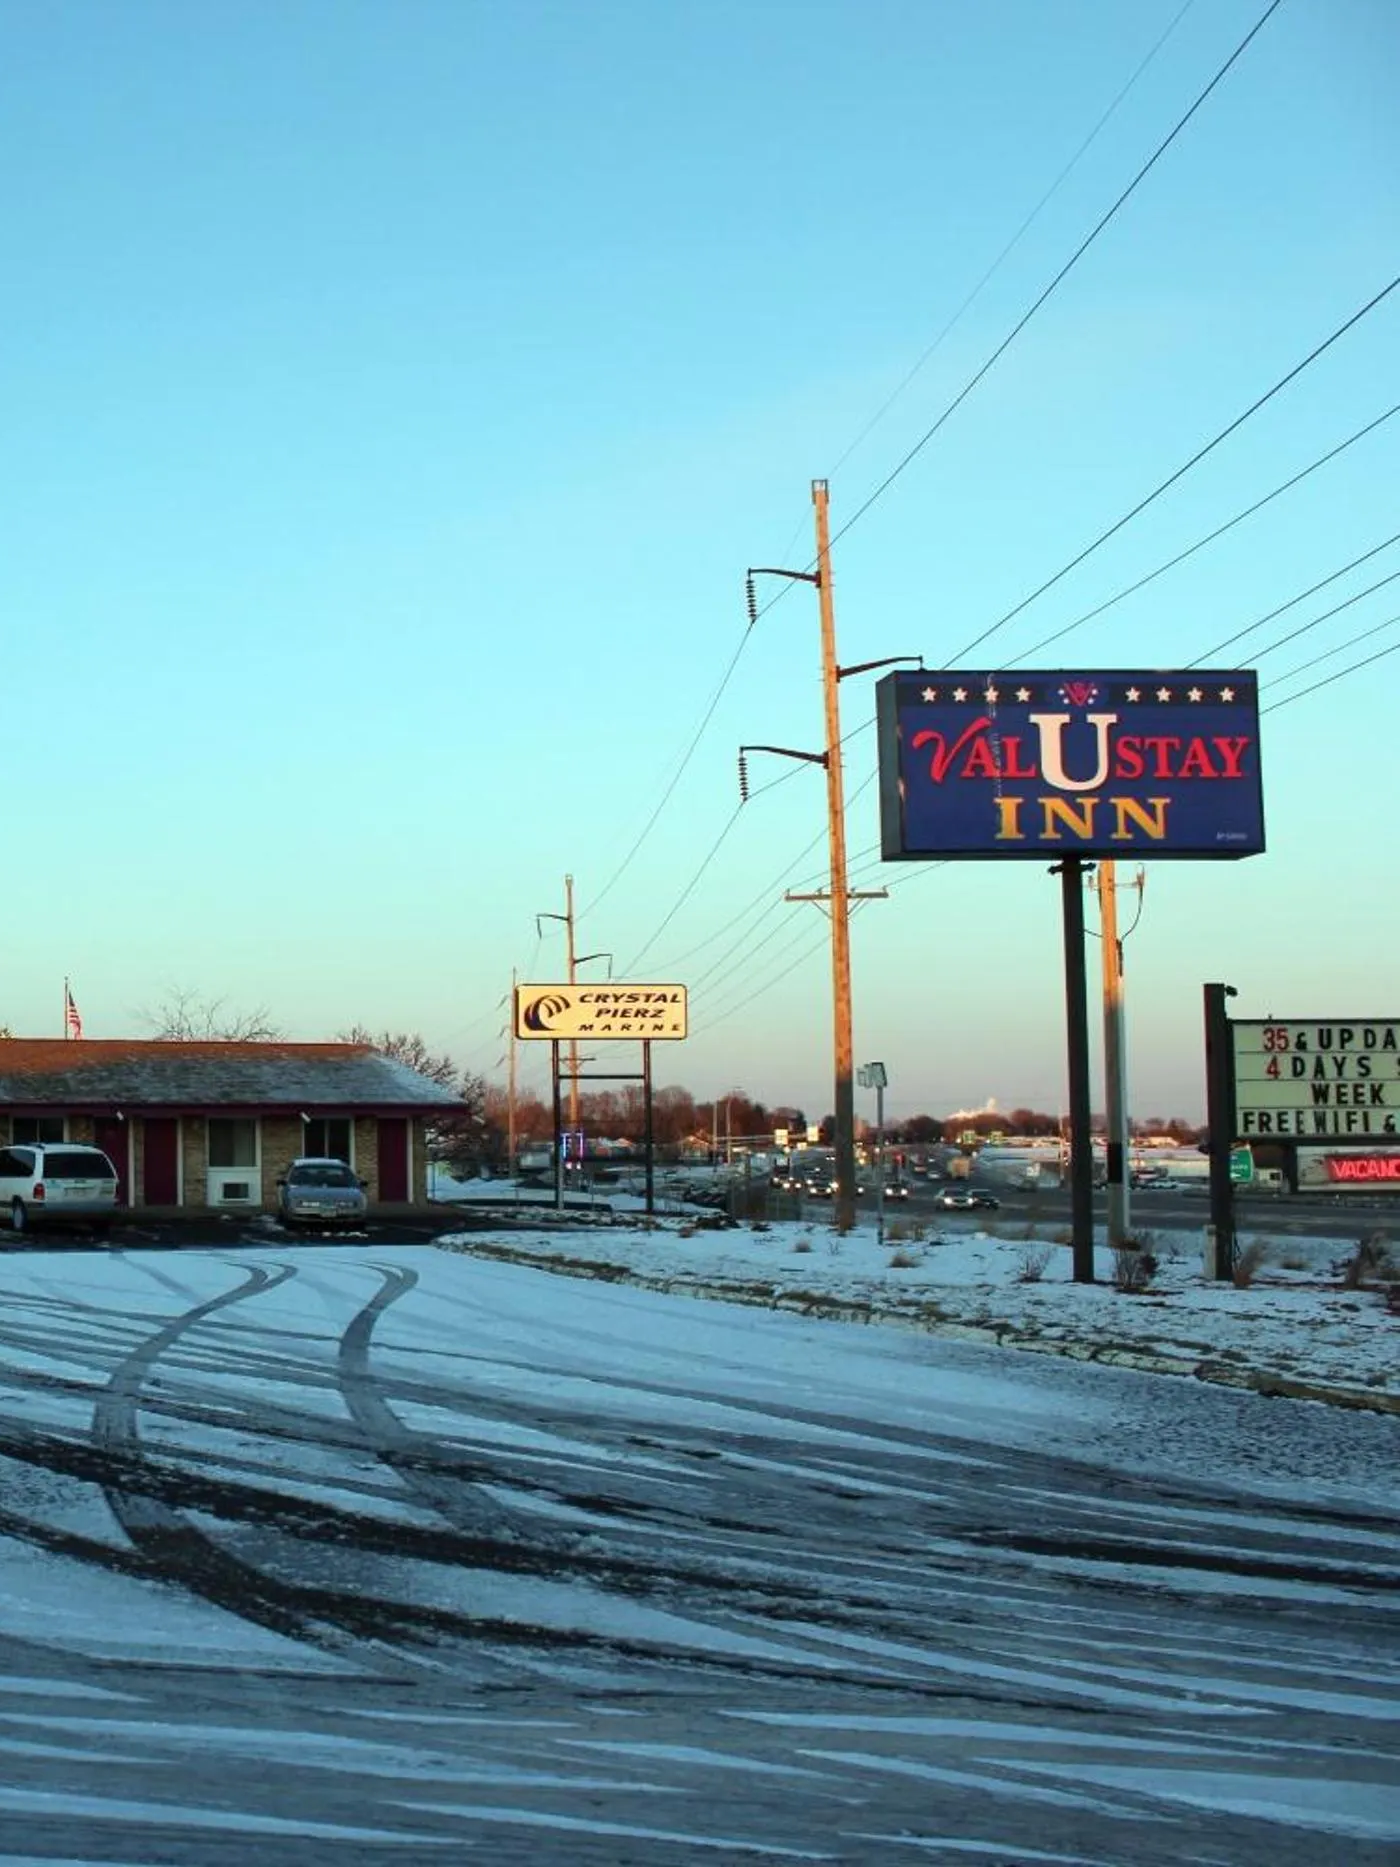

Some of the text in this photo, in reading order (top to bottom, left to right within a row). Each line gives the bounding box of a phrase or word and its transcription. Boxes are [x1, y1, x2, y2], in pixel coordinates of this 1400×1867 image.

[993, 797, 1171, 840] INN
[579, 993, 682, 1003] CRYSTAL
[595, 1008, 666, 1018] PIERZ
[1265, 1055, 1282, 1080] 4
[1291, 1055, 1372, 1080] DAYS
[1311, 1082, 1385, 1105] WEEK
[1243, 1110, 1305, 1135] FREE
[1313, 1110, 1371, 1134] WIFI
